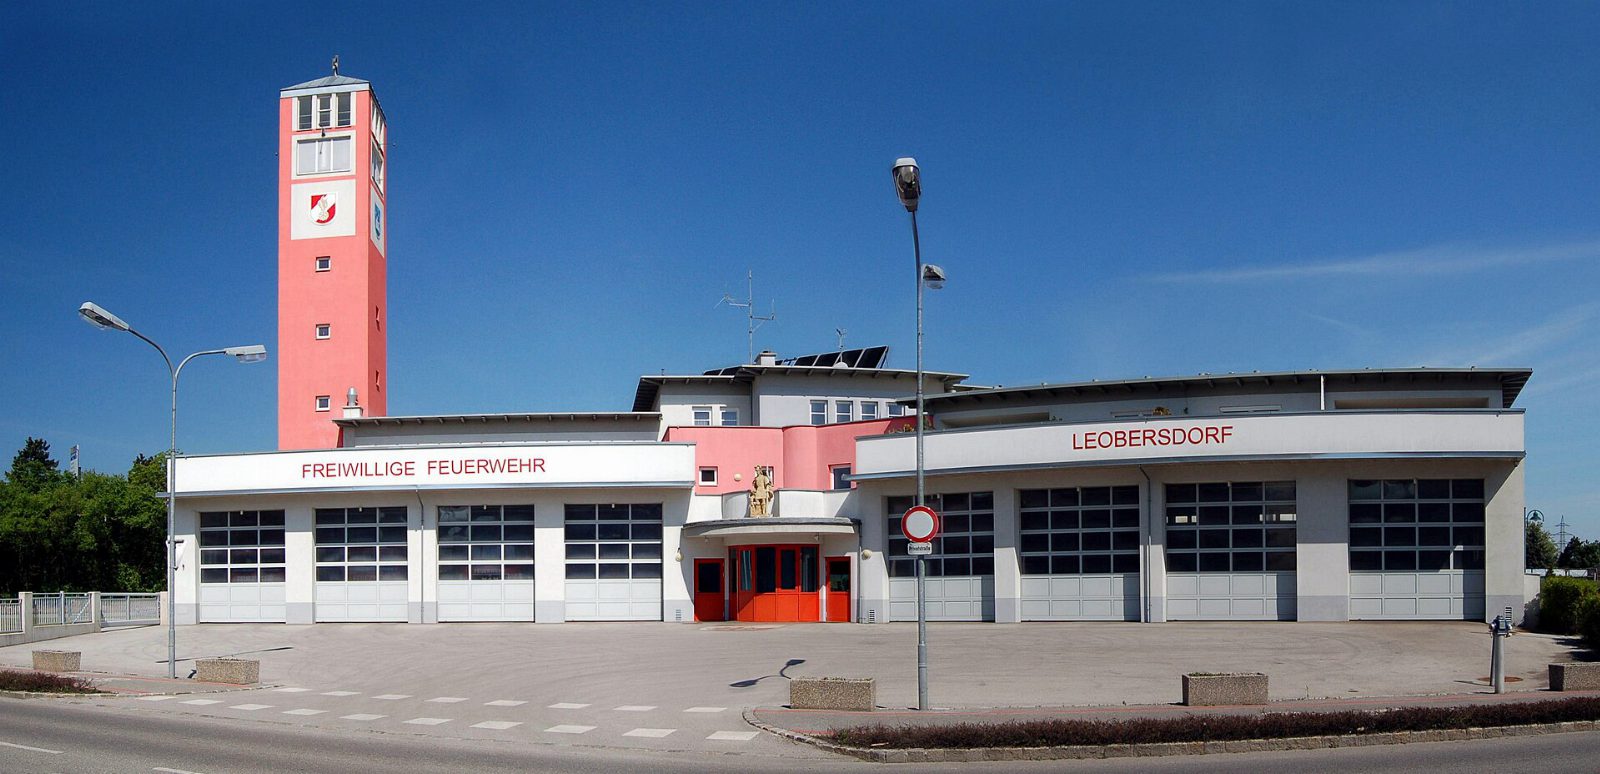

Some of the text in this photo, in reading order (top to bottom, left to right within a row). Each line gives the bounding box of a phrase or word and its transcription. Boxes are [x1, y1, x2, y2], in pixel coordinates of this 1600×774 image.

[1072, 426, 1233, 450] LEOBERSDORF
[302, 458, 546, 478] FREIWILLIGE FEUERWEHR
